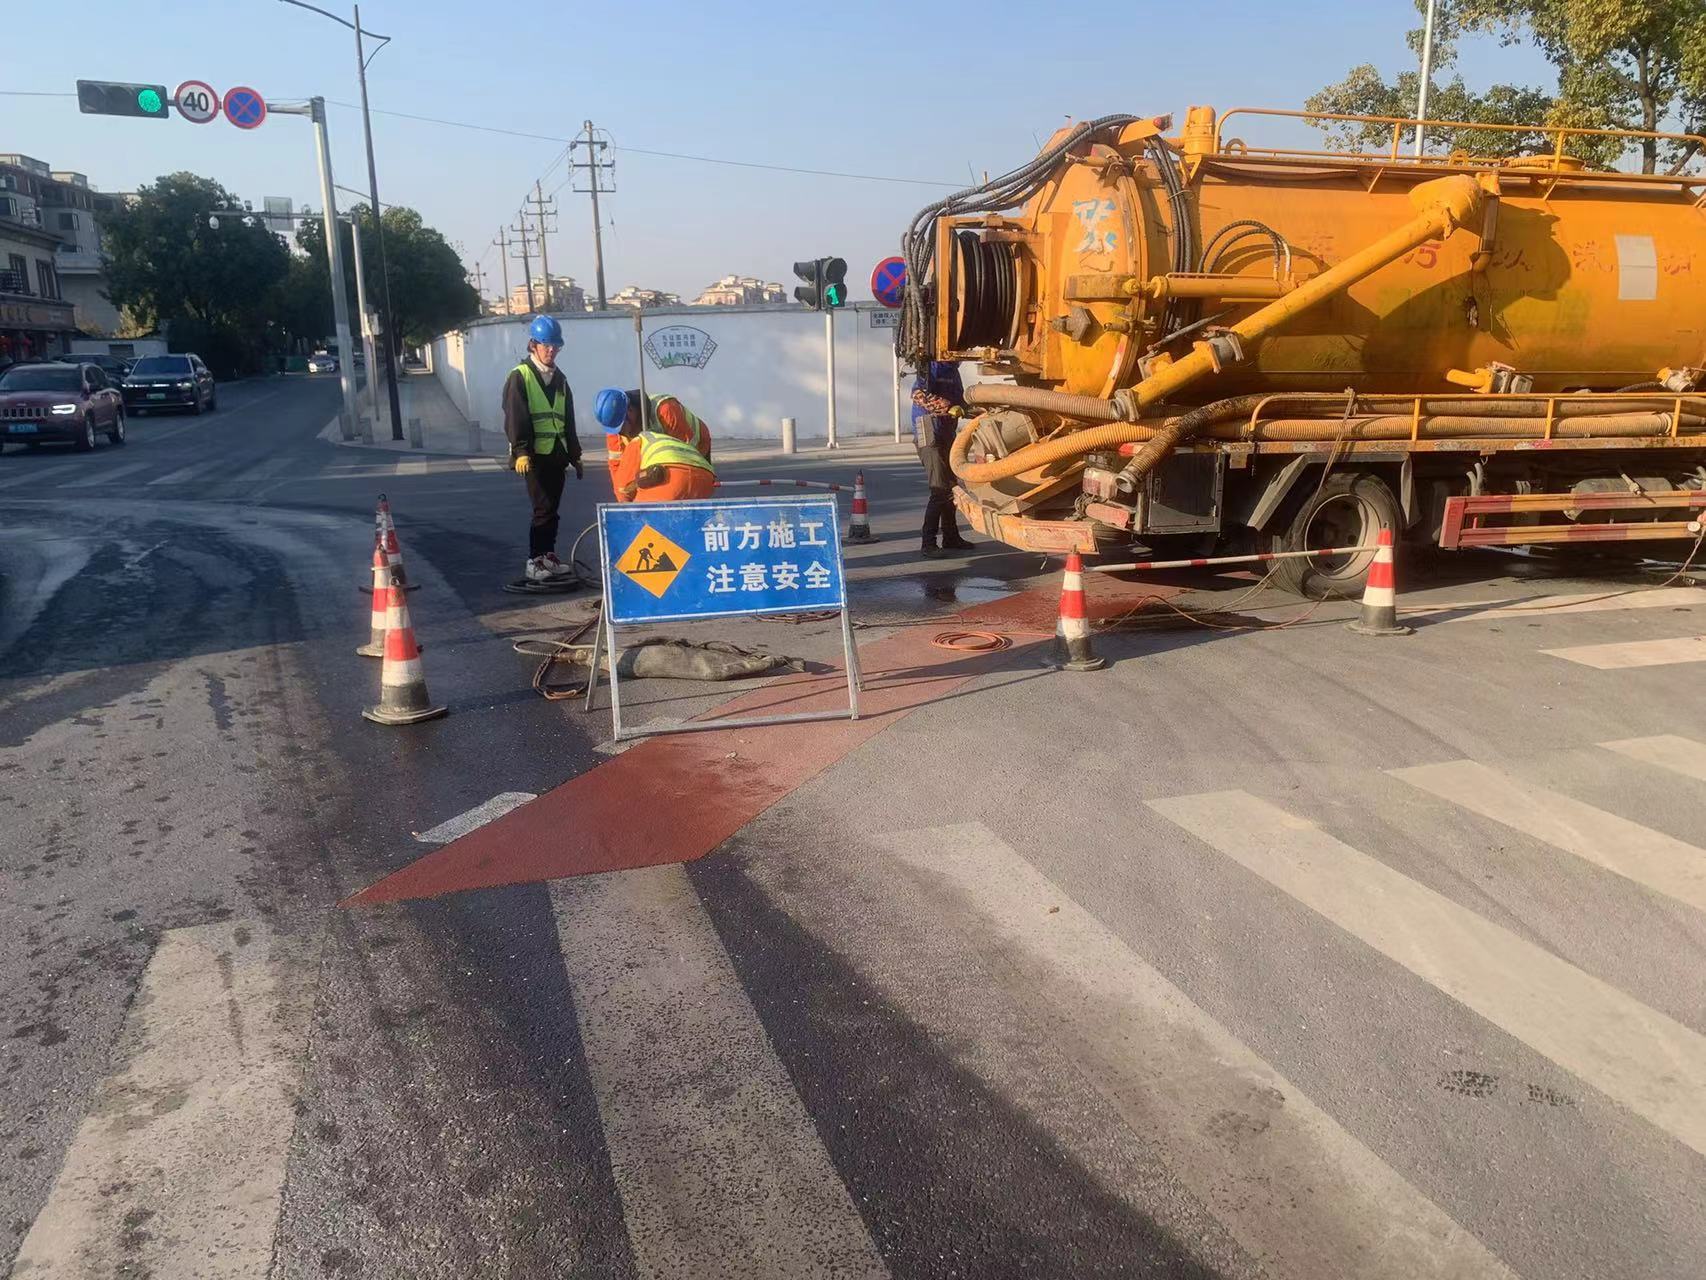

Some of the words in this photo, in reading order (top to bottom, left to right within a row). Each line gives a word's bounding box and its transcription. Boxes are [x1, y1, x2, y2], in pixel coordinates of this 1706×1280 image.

[183, 91, 209, 112] 40
[702, 520, 828, 553] 前方施工
[707, 559, 832, 594] 注意安全
